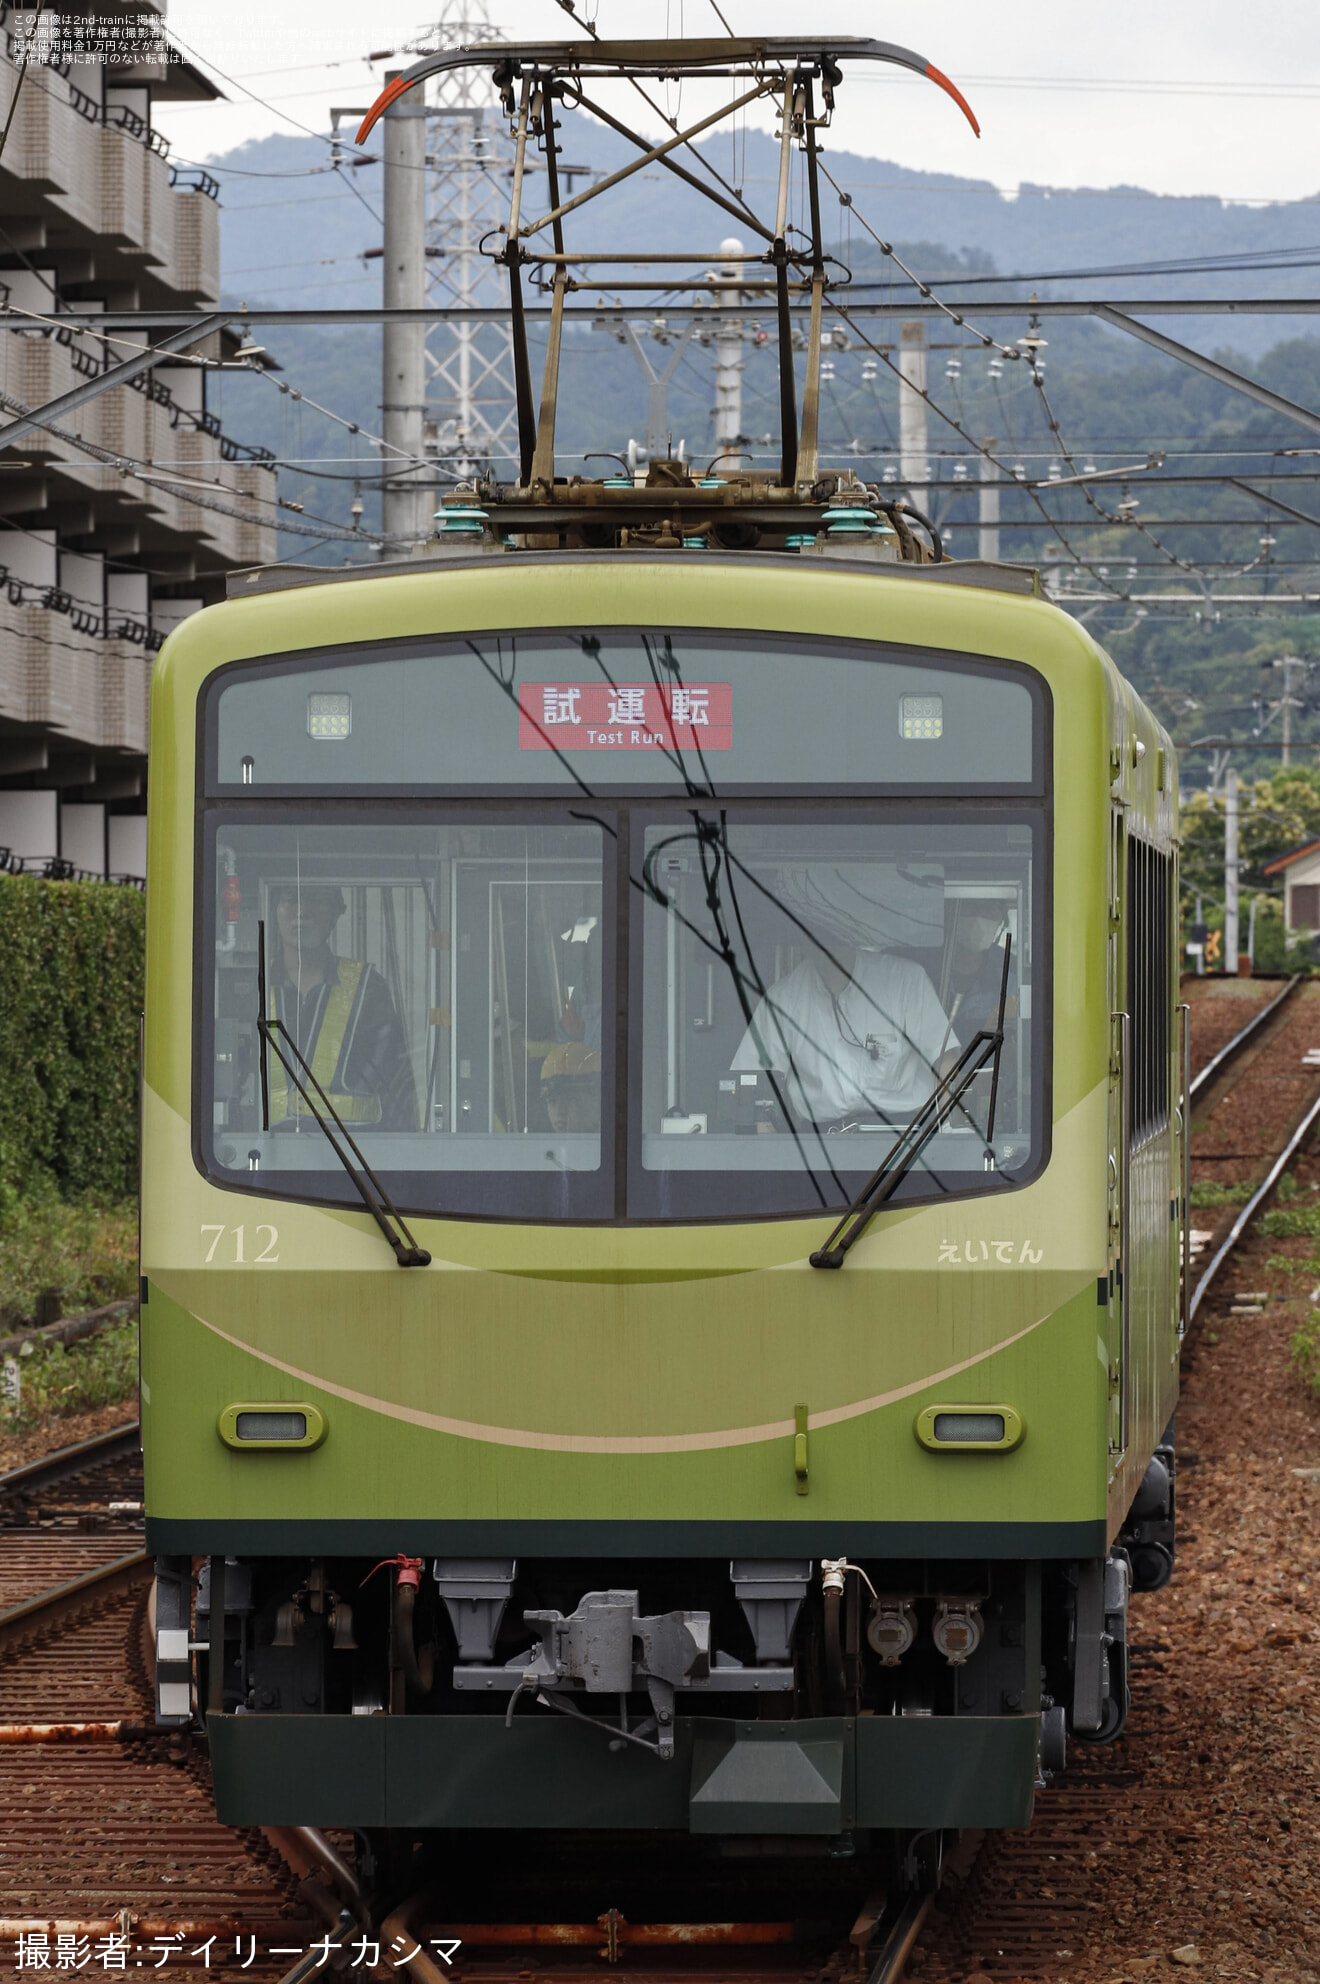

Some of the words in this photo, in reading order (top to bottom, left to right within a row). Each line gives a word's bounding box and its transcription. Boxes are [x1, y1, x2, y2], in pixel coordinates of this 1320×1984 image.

[543, 687, 709, 725] 試運転
[587, 730, 624, 744] Test
[630, 730, 664, 744] Run
[200, 1224, 280, 1263] 712
[937, 1239, 1044, 1264] えいでん
